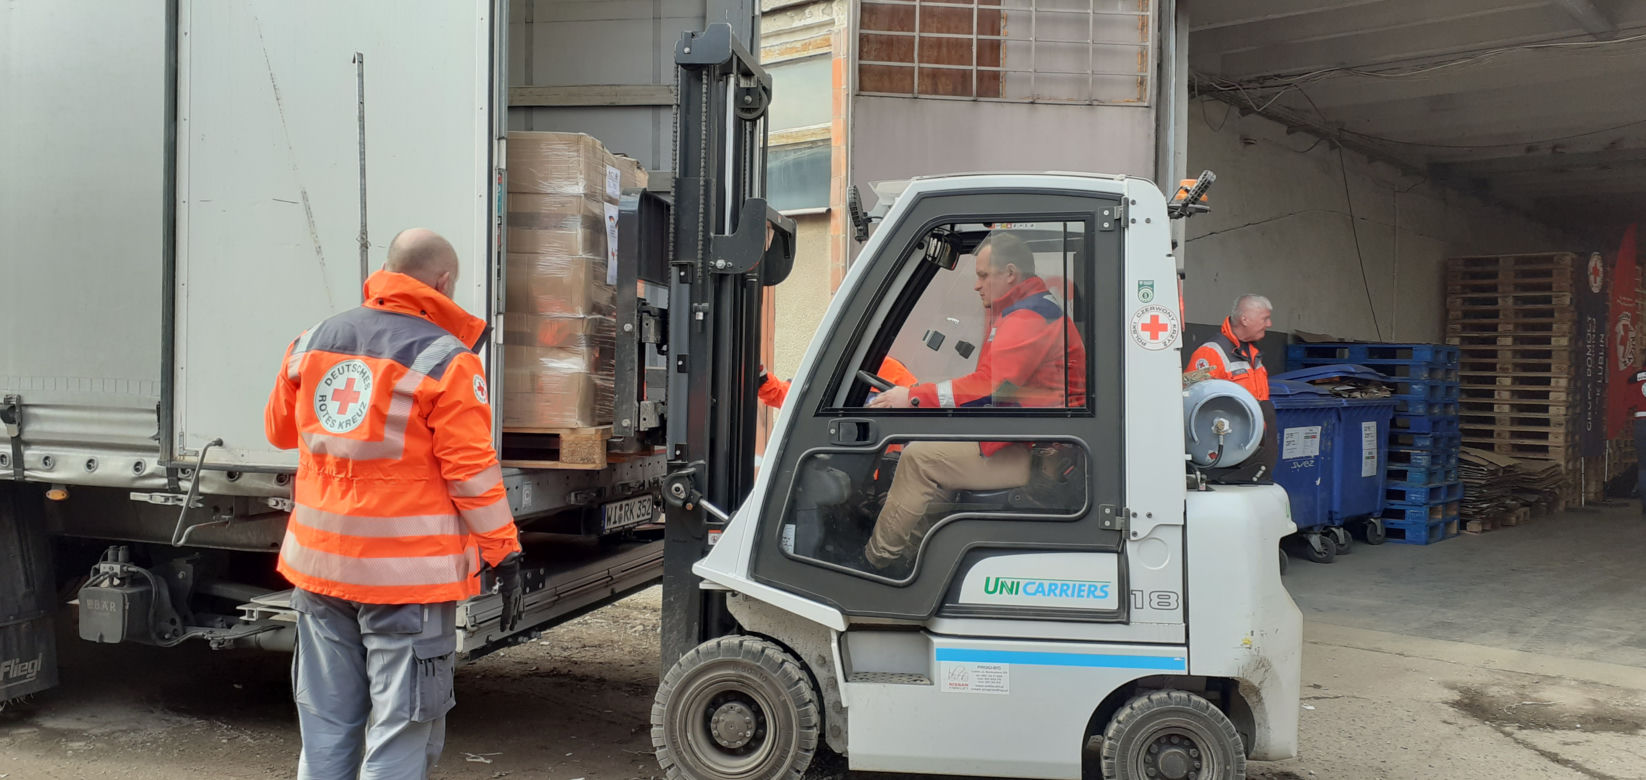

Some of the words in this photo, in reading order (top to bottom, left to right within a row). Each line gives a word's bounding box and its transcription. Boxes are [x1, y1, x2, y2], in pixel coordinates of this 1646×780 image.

[1136, 306, 1175, 321] CZERWONY
[324, 363, 371, 391] DEUTSCHES
[318, 394, 337, 428] ROTES
[337, 401, 367, 430] KREUZ
[623, 502, 635, 522] RK
[636, 498, 652, 519] 352
[1130, 589, 1180, 610] 18
[0, 653, 43, 681] Fliegl
